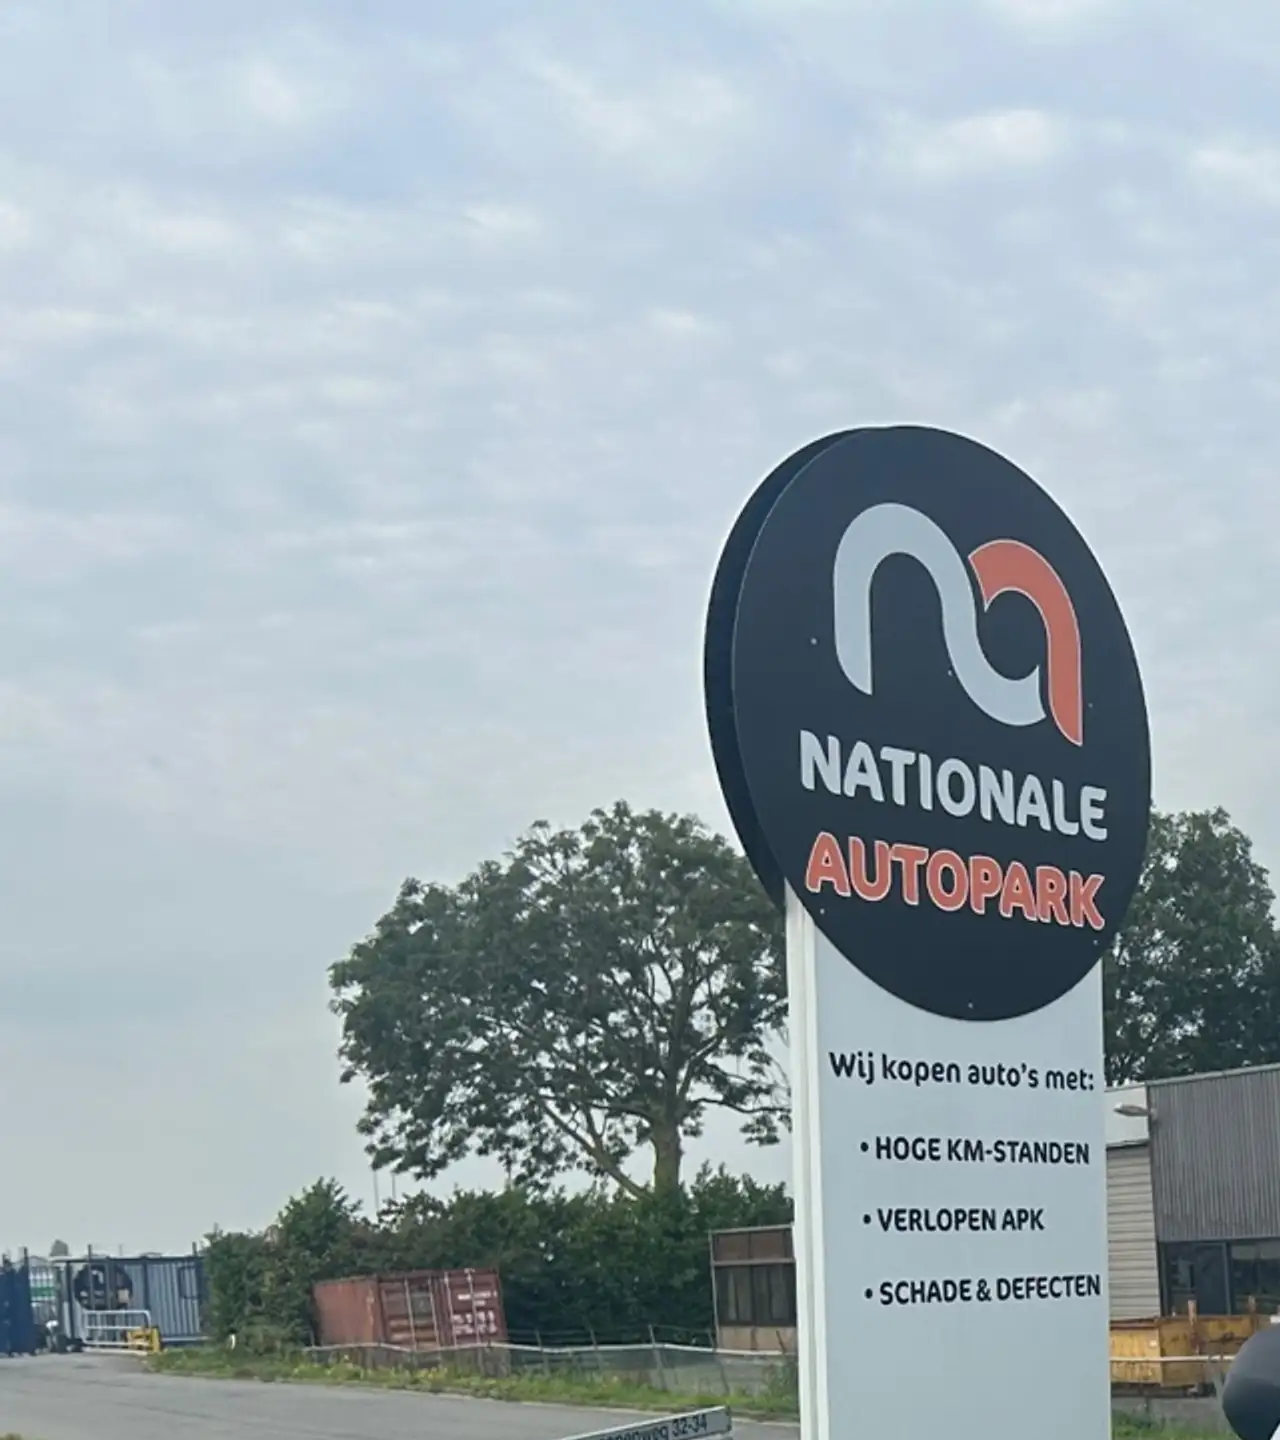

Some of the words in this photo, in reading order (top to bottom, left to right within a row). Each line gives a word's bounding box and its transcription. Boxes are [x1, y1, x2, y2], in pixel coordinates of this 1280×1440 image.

[800, 729, 1107, 840] NATIONALE
[805, 832, 1105, 930] AUTOPARK
[829, 1051, 874, 1085] Wij
[882, 1054, 961, 1086] kopen
[968, 1062, 1039, 1088] auto's
[1046, 1068, 1094, 1091] met:
[876, 1136, 941, 1161] HOGE
[948, 1138, 1090, 1164] KM-STANDEN
[877, 1208, 996, 1232] VERLOPEN
[1001, 1208, 1045, 1231] APK
[880, 1280, 972, 1305] SCHADE
[976, 1279, 992, 1301] &
[996, 1274, 1100, 1300] DEFECTEN
[671, 1414, 708, 1437] 32-34
